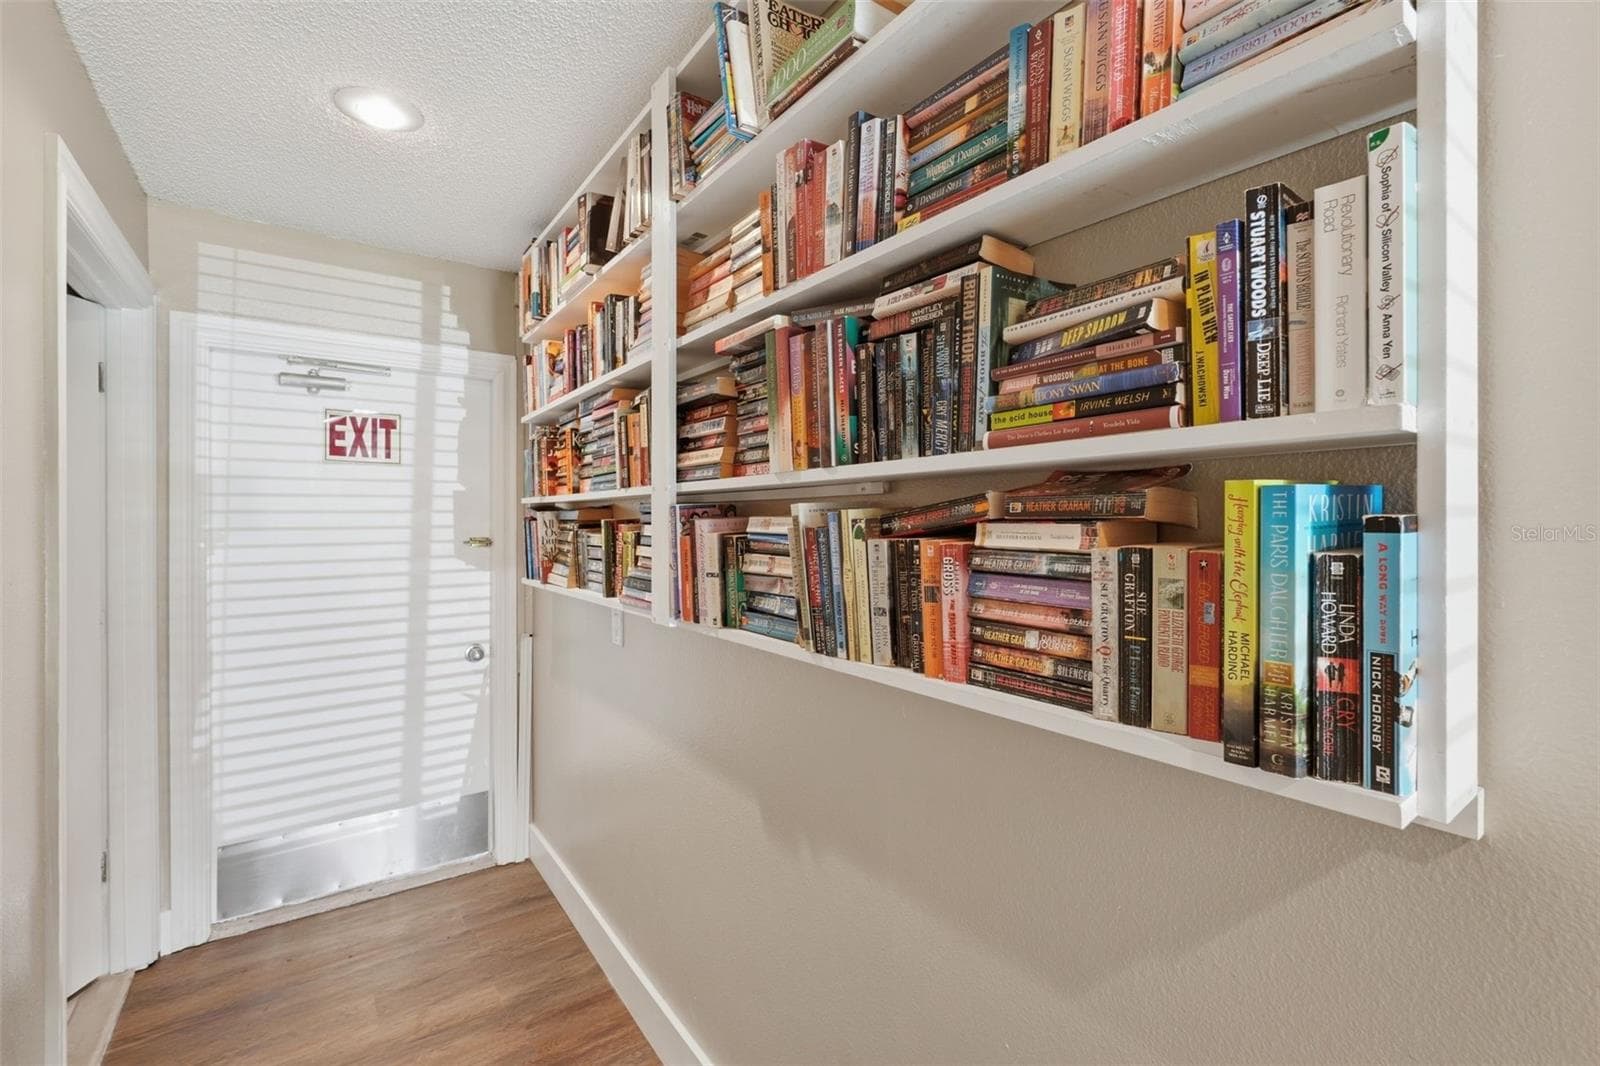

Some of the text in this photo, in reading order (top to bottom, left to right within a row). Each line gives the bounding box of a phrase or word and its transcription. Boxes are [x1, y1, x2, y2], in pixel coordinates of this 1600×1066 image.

[1095, 0, 1108, 92] USAN WIGGS
[1153, 13, 1163, 48] WIGGS
[1114, 44, 1127, 81] WIGGS
[1061, 47, 1074, 123] SUSAN WIGGS
[1324, 199, 1338, 233] Road
[1341, 193, 1356, 277] Revolutionary
[1381, 166, 1393, 293] Sophia of Silicon Valley
[1250, 210, 1268, 320] STUART WOODS
[911, 303, 943, 317] WHITLEY
[962, 279, 976, 364] BRAD THOR
[1194, 270, 1218, 345] IN PLAIN VIEW
[1336, 295, 1349, 369] Richard Yates
[1382, 314, 1392, 359] Anna Yen
[1043, 370, 1074, 383] WOODSON
[1111, 360, 1125, 371] THE
[1127, 356, 1148, 368] BONE
[1256, 341, 1272, 403] DEEP LIE
[1068, 381, 1100, 395] SWAN
[1080, 392, 1150, 411] IRVINE WELSH
[935, 400, 949, 453] CRY MERCY
[994, 408, 1053, 424] the acid house
[329, 415, 397, 460] EXIT
[1025, 500, 1091, 512] HEATHER GRAHAM
[1307, 493, 1374, 522] KRISTIN
[983, 557, 1012, 569] HEATHER
[1227, 494, 1249, 623] Hanging with the Elephant
[1378, 543, 1388, 553] A
[943, 557, 954, 596] GROSS
[1100, 583, 1111, 600] SUE
[1270, 491, 1288, 660] THE PARIS DAUGHTER
[1378, 557, 1388, 590] LONG
[1124, 573, 1135, 632] GRAFTON
[1137, 592, 1147, 615] SUE
[1379, 594, 1388, 616] WAY
[983, 630, 1010, 641] HEATHER
[1100, 602, 1109, 643] GRAFTON
[1171, 611, 1184, 673] ELIZABETH GEORGE
[1320, 592, 1337, 654] HOWARD
[1338, 604, 1356, 643] LINDA
[911, 634, 920, 669] GRISHAM
[984, 651, 1014, 664] HEATHER
[1056, 665, 1093, 680] SILENCED
[1227, 630, 1238, 680] HARDING
[1239, 632, 1250, 681] MICHAEL
[1099, 676, 1110, 707] Quarry
[1371, 656, 1382, 752] NICK HORNBY
[1278, 692, 1293, 750] KRISTIN
[1336, 697, 1356, 733] CRY
